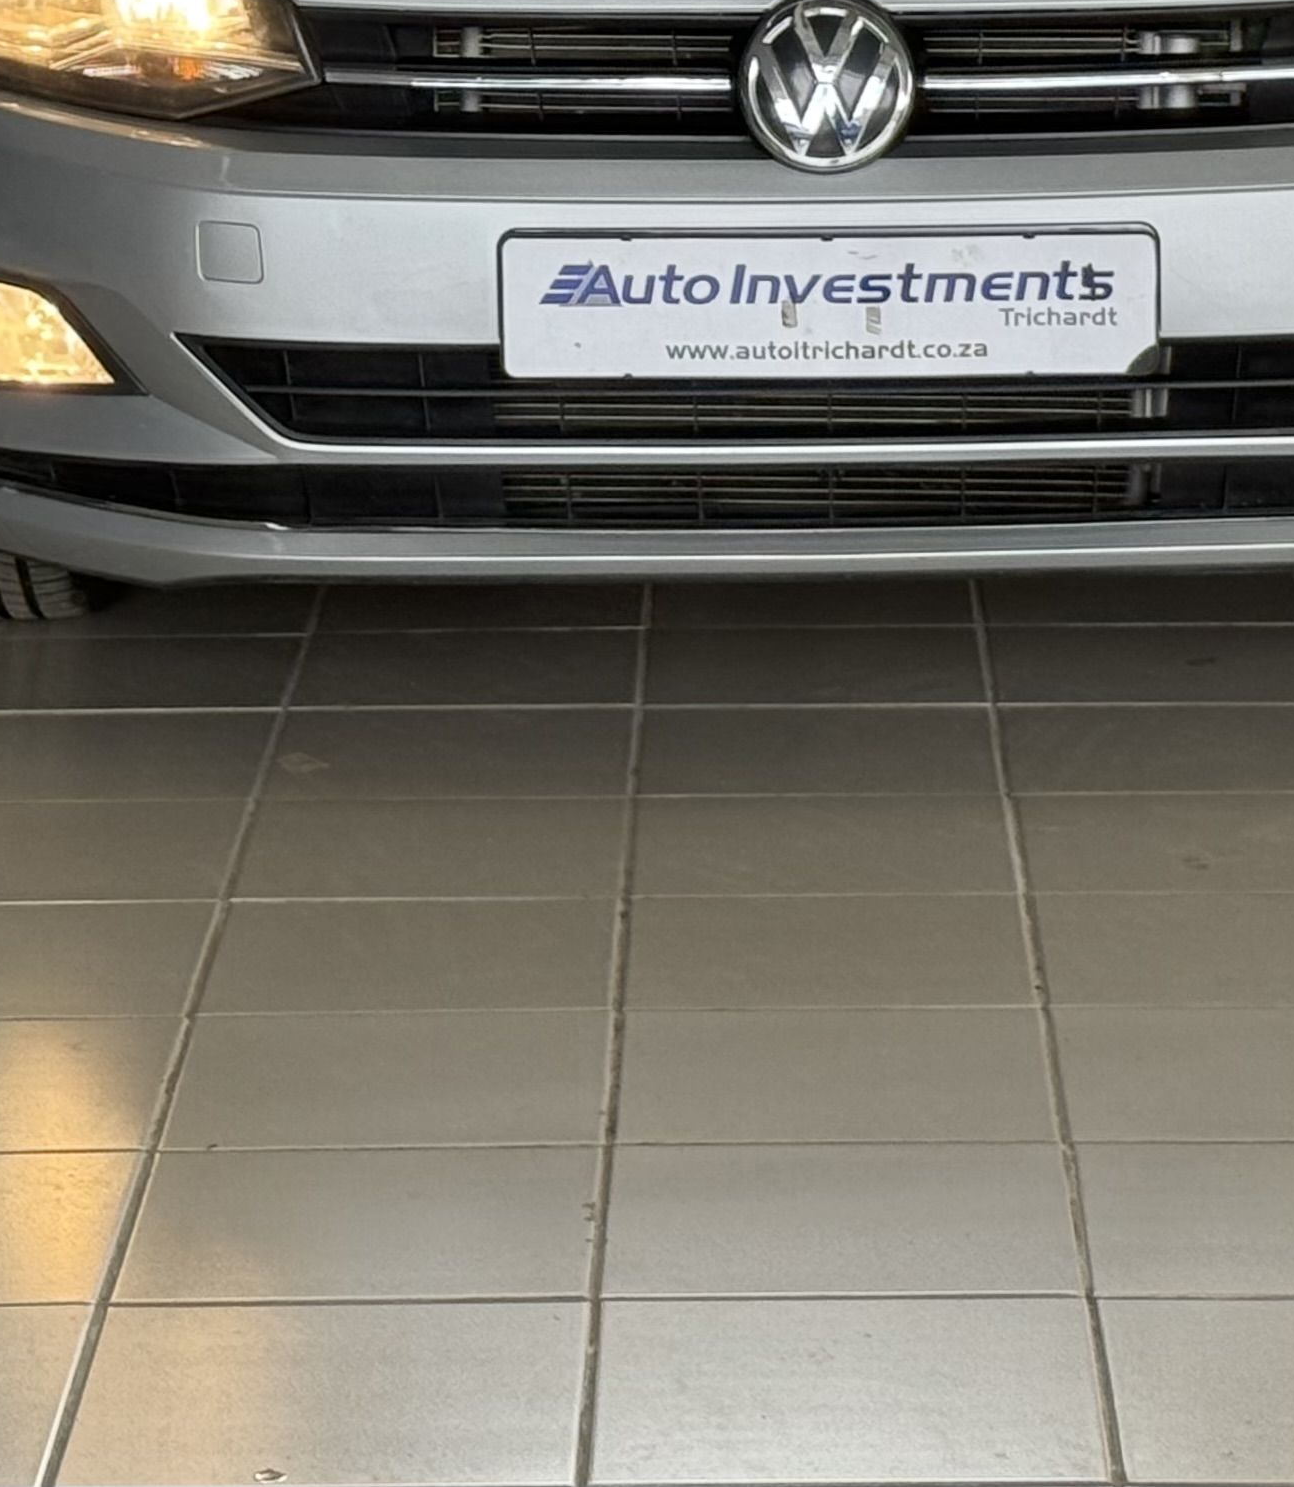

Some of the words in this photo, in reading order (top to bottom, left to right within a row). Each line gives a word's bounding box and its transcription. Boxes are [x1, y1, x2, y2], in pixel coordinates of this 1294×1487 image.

[752, 0, 901, 159] VW
[574, 265, 720, 306] Auto
[730, 262, 1114, 304] Investments
[999, 308, 1118, 326] Trichardt
